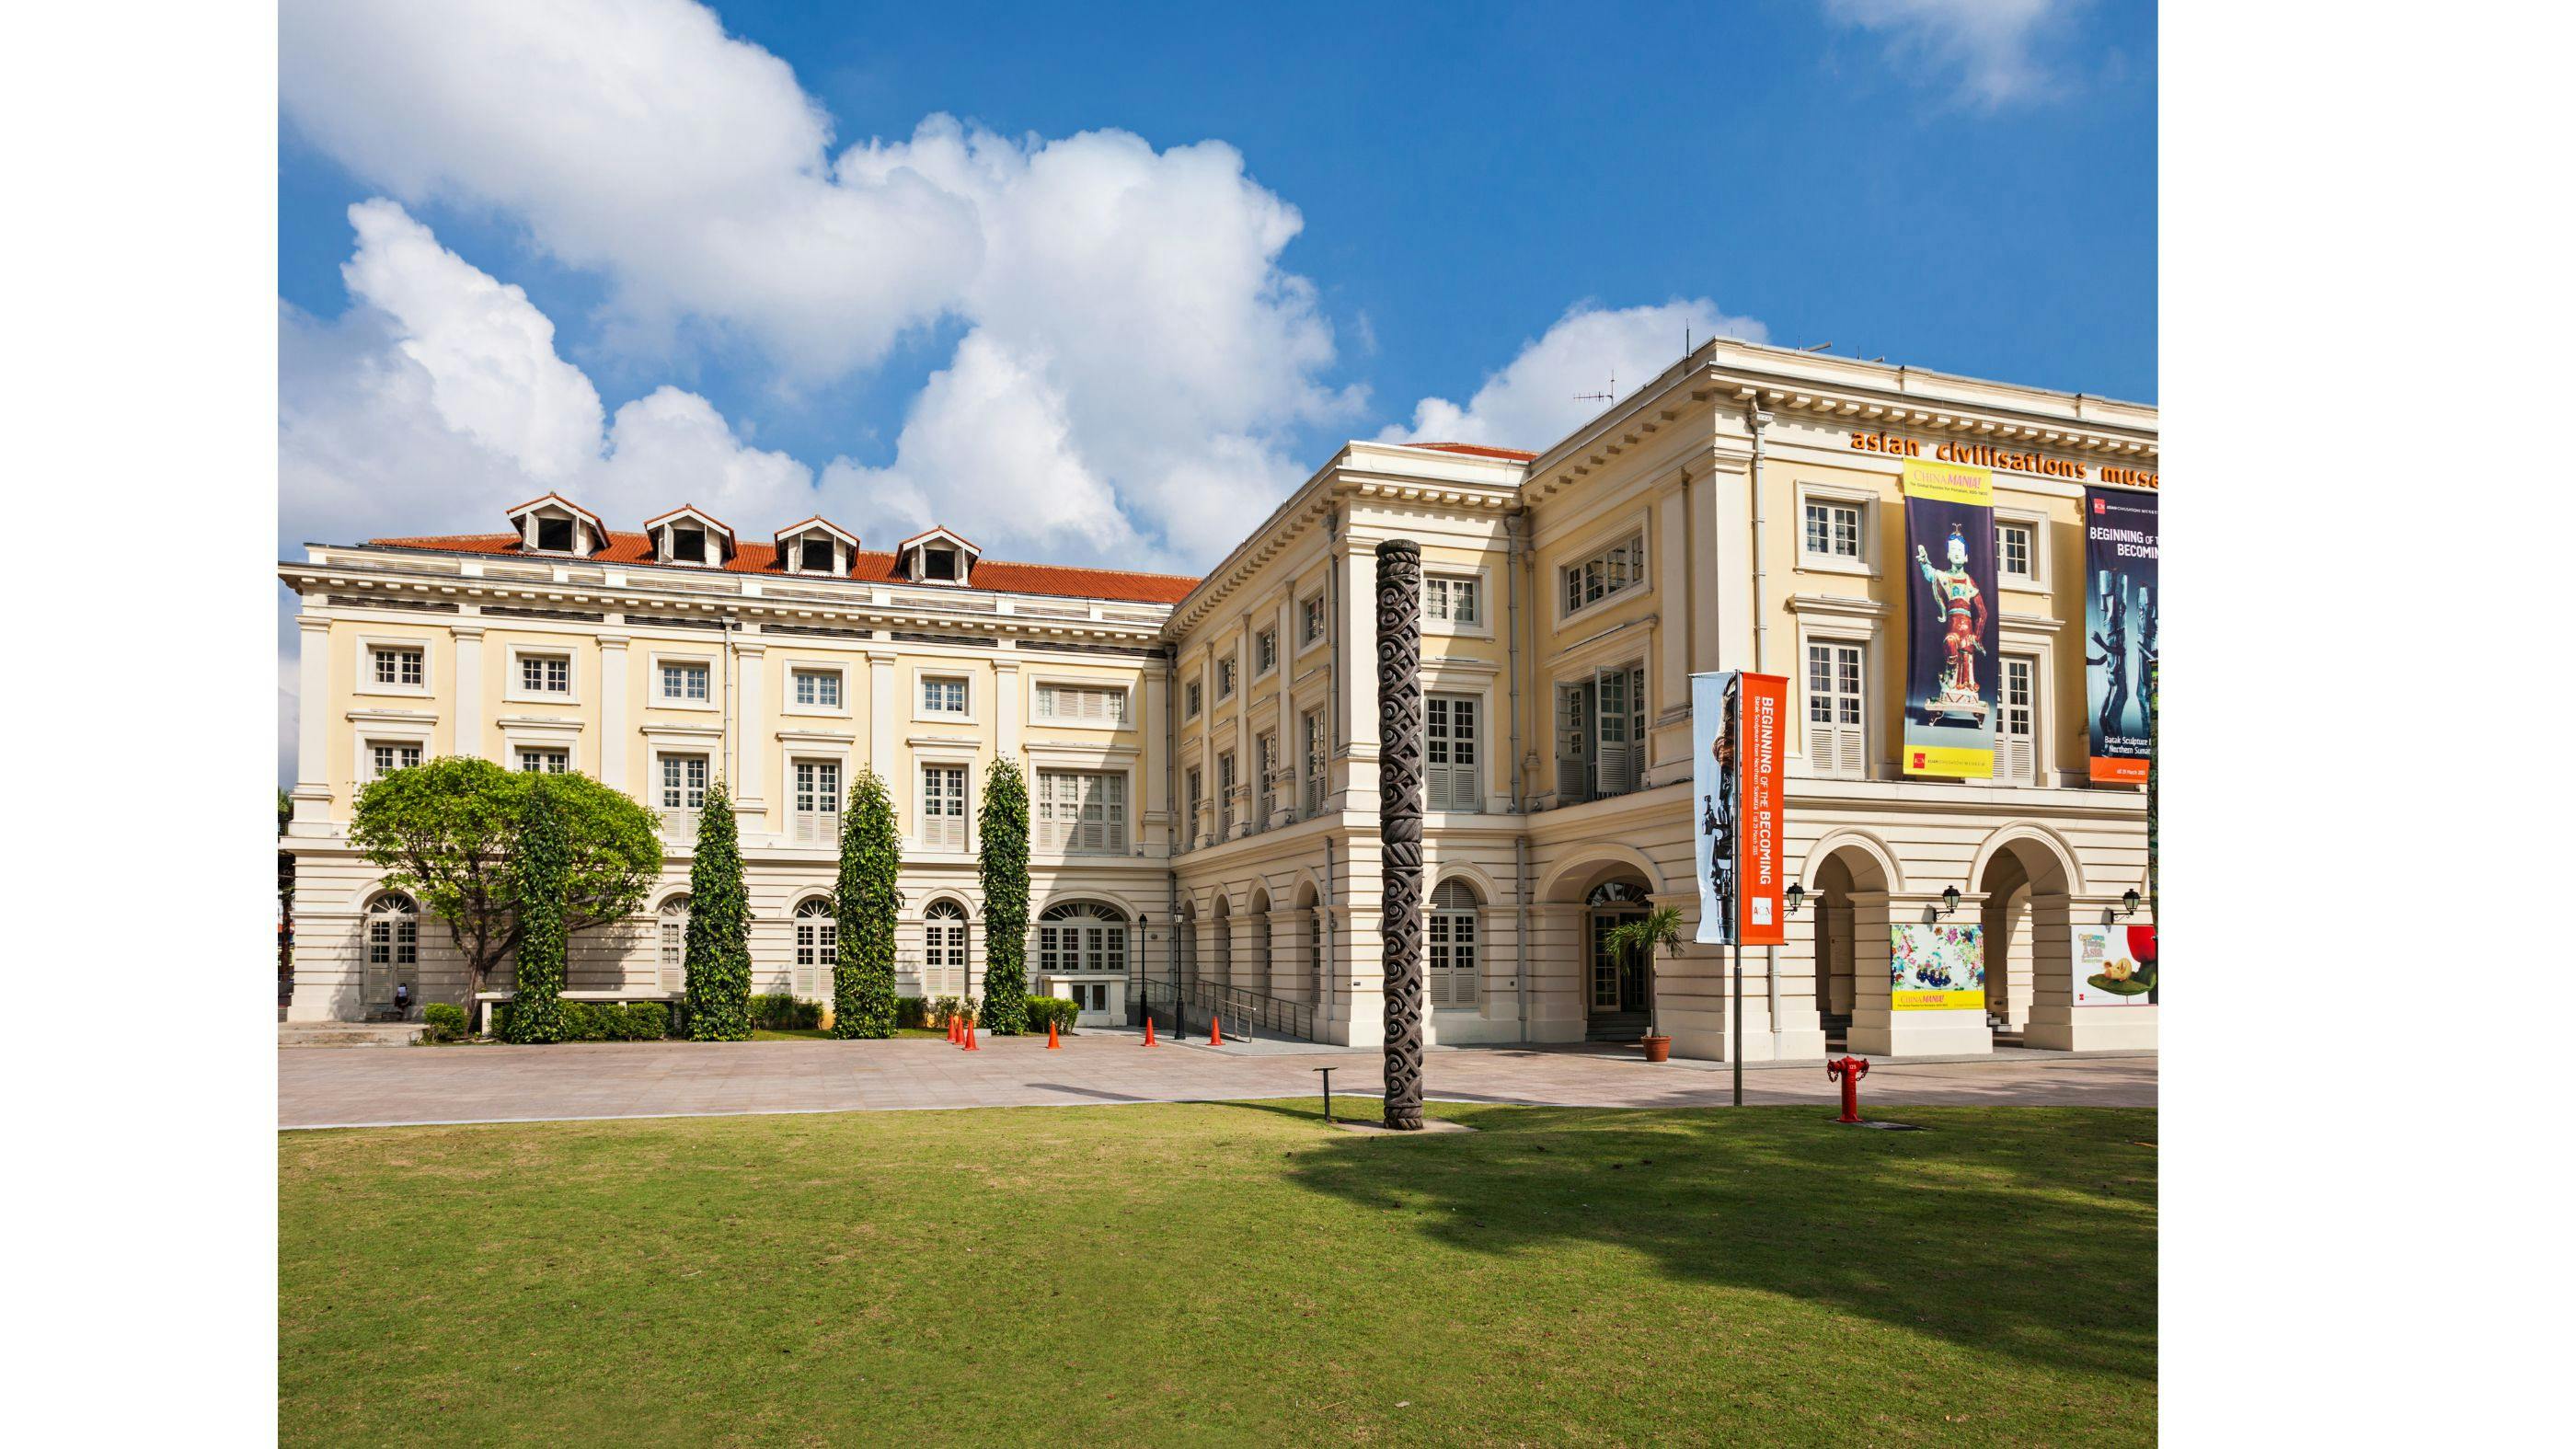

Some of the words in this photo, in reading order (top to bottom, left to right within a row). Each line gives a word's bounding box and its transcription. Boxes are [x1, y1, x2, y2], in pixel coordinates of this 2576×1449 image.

[1850, 431, 1919, 456] asian
[1936, 441, 2087, 479] civilisations
[2089, 526, 2144, 544] BEGINNING
[2145, 535, 2154, 545] OF
[1760, 696, 1774, 774] BEGINNING
[2104, 736, 2122, 744] Batak
[2122, 736, 2147, 746] Sculpture
[2109, 745, 2133, 754] Northern
[1760, 776, 1768, 788] OF
[1760, 791, 1768, 808] THE
[1759, 811, 1771, 885] BECOMING
